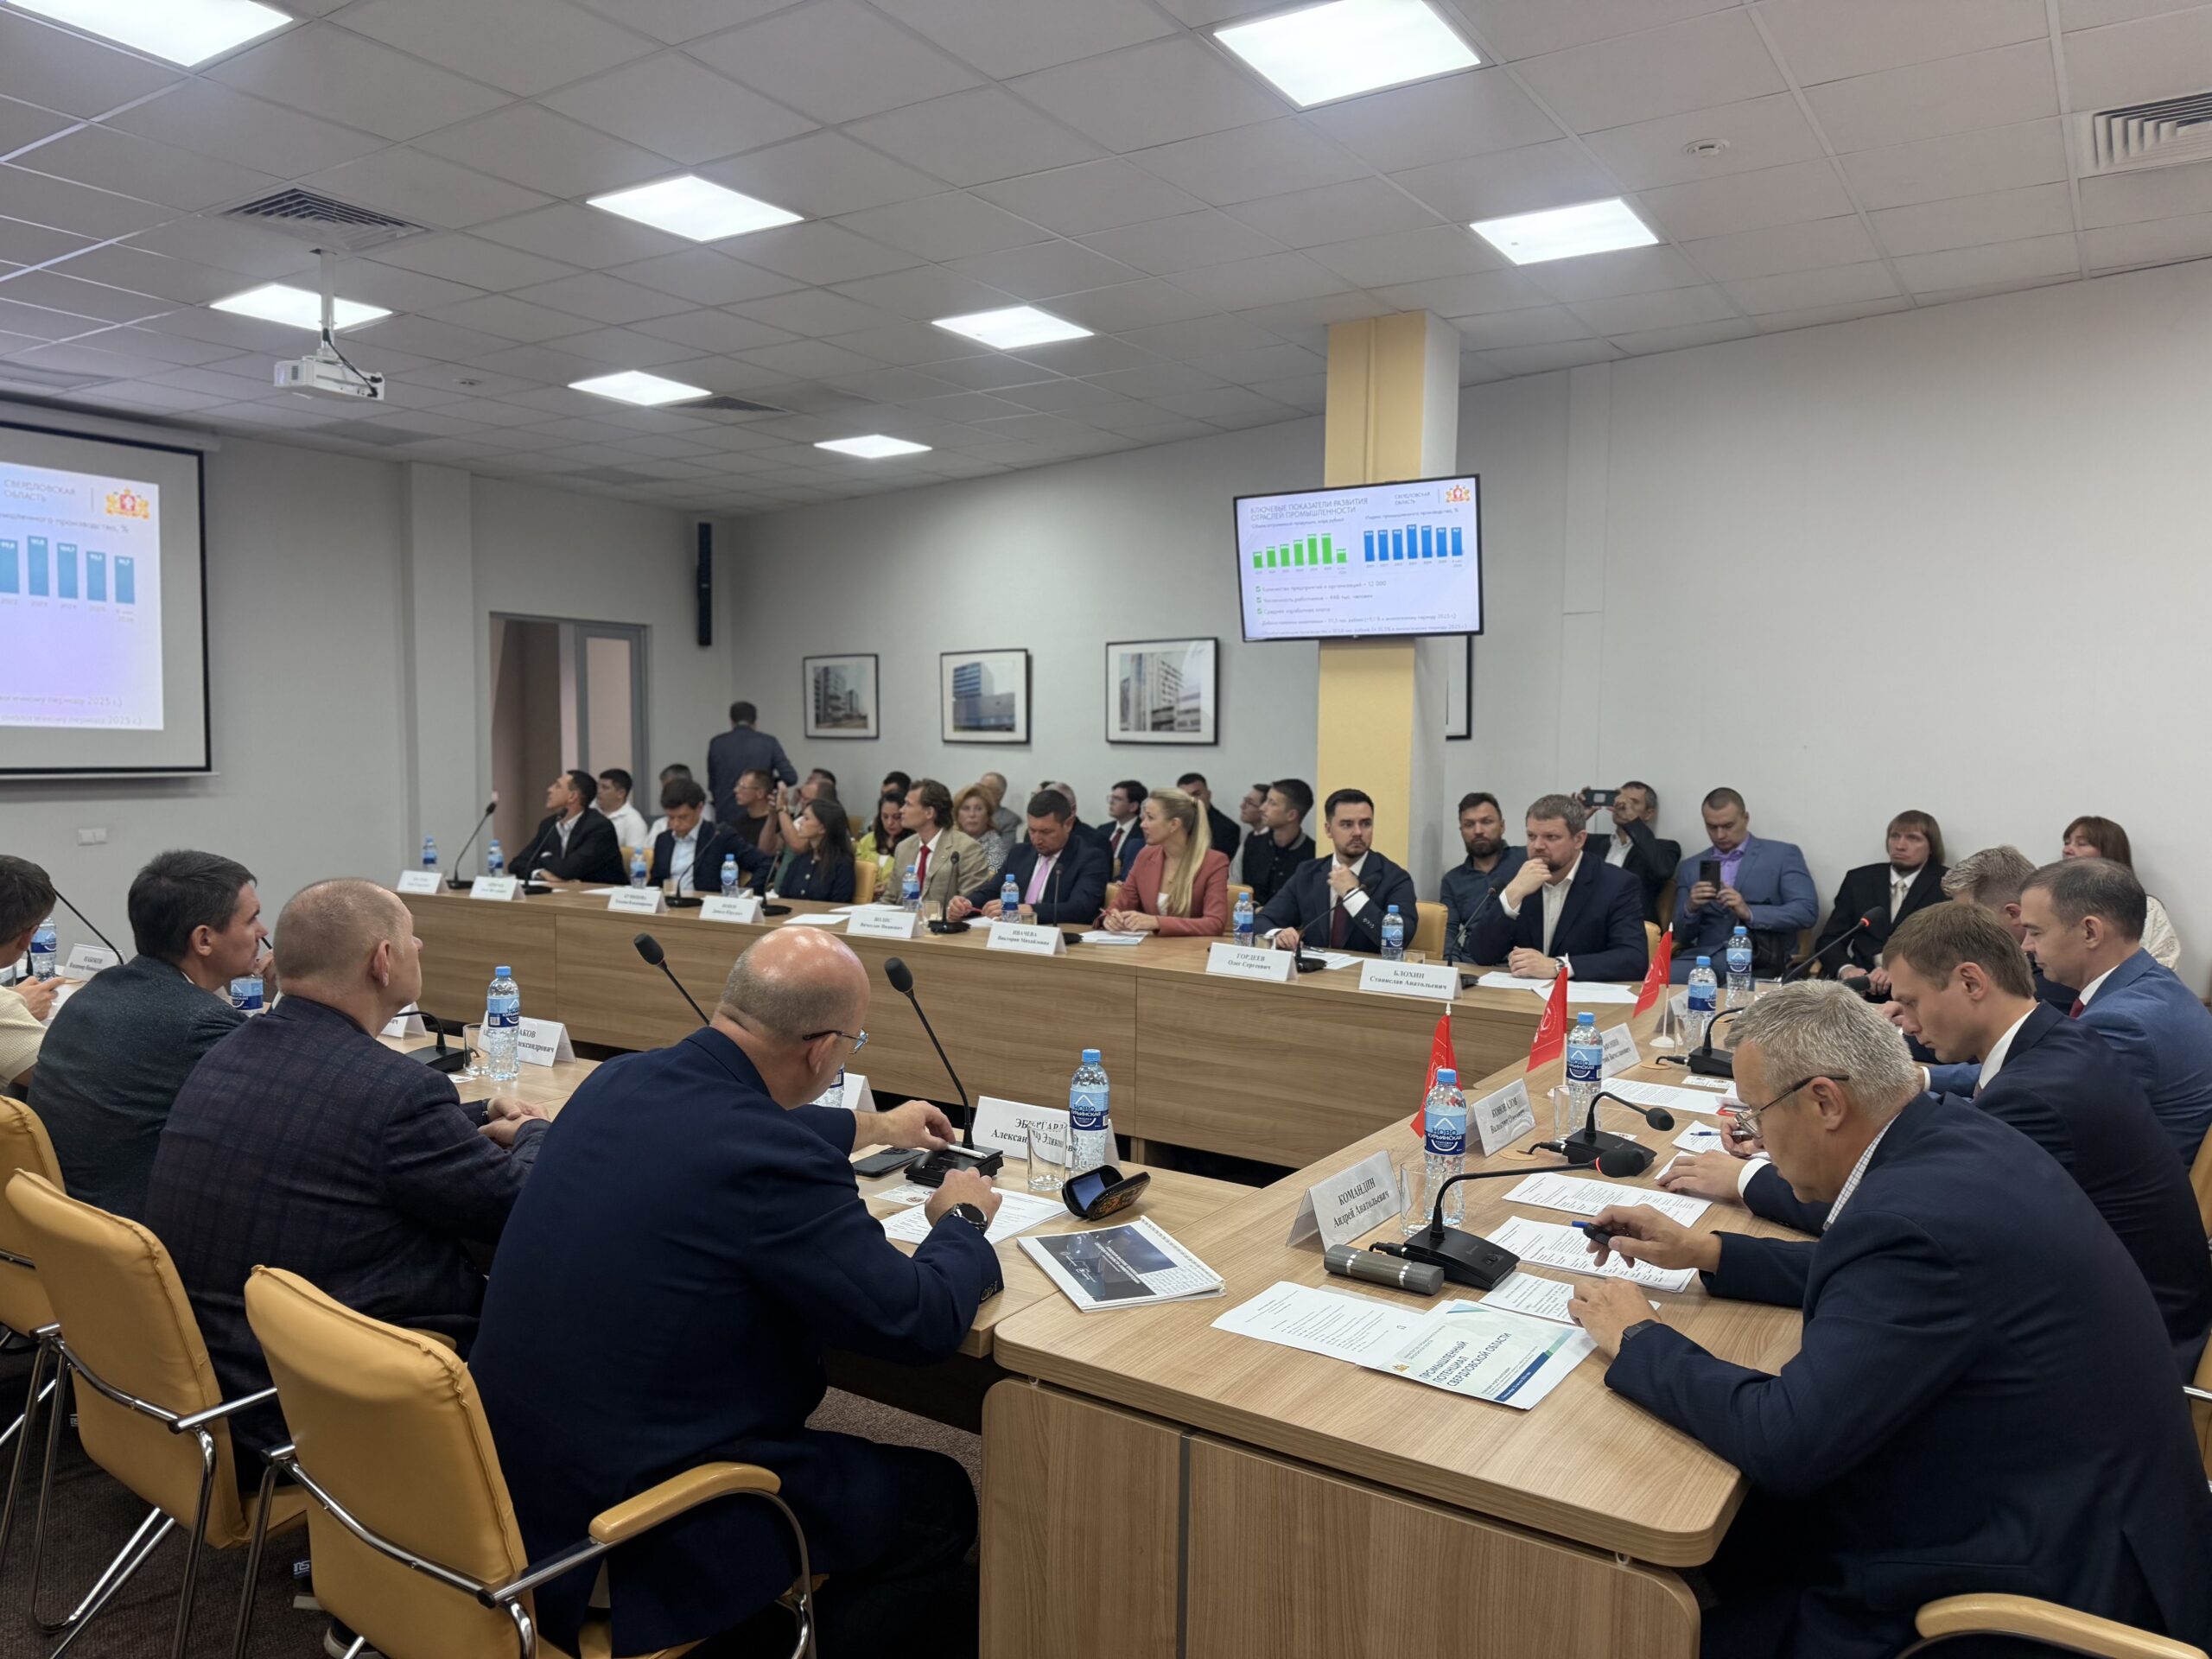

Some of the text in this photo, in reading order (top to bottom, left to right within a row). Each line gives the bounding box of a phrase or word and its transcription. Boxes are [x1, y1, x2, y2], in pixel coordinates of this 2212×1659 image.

[4, 479, 75, 495] СВЕРДЛОВСКАЯ
[4, 490, 47, 502] ОБЛАСТЬ
[1251, 498, 1369, 514] КЛЮЧЕВЫЕ ПОКАЗАТЕЛИ РАЗВИТИЯ
[1251, 506, 1356, 521] ОТРАСЛЕЙ ПРОМЫШЛЕННОСТИ
[1236, 953, 1265, 962] ГОРДЕЕВ
[1242, 961, 1271, 970] Сергеевич
[1394, 969, 1425, 979] БЛОХИН
[1370, 976, 1447, 990] Станислав Анатольевич
[518, 1040, 554, 1052] лександрович
[1073, 1103, 1096, 1113] НОВО
[1432, 1127, 1458, 1136] НОВО
[1338, 1177, 1376, 1206] КОМАНДИН
[1333, 1190, 1390, 1229] Андрей Анатольевич
[1418, 1340, 1470, 1380] ПРОМЫШЛЕННЫЙ
[1446, 1350, 1491, 1387] СВЕРДЛОВСКОЙ
[1485, 1332, 1513, 1354] ОБЛАСТИ
[1433, 1356, 1469, 1383] ПОТЕНЦИАЛ
